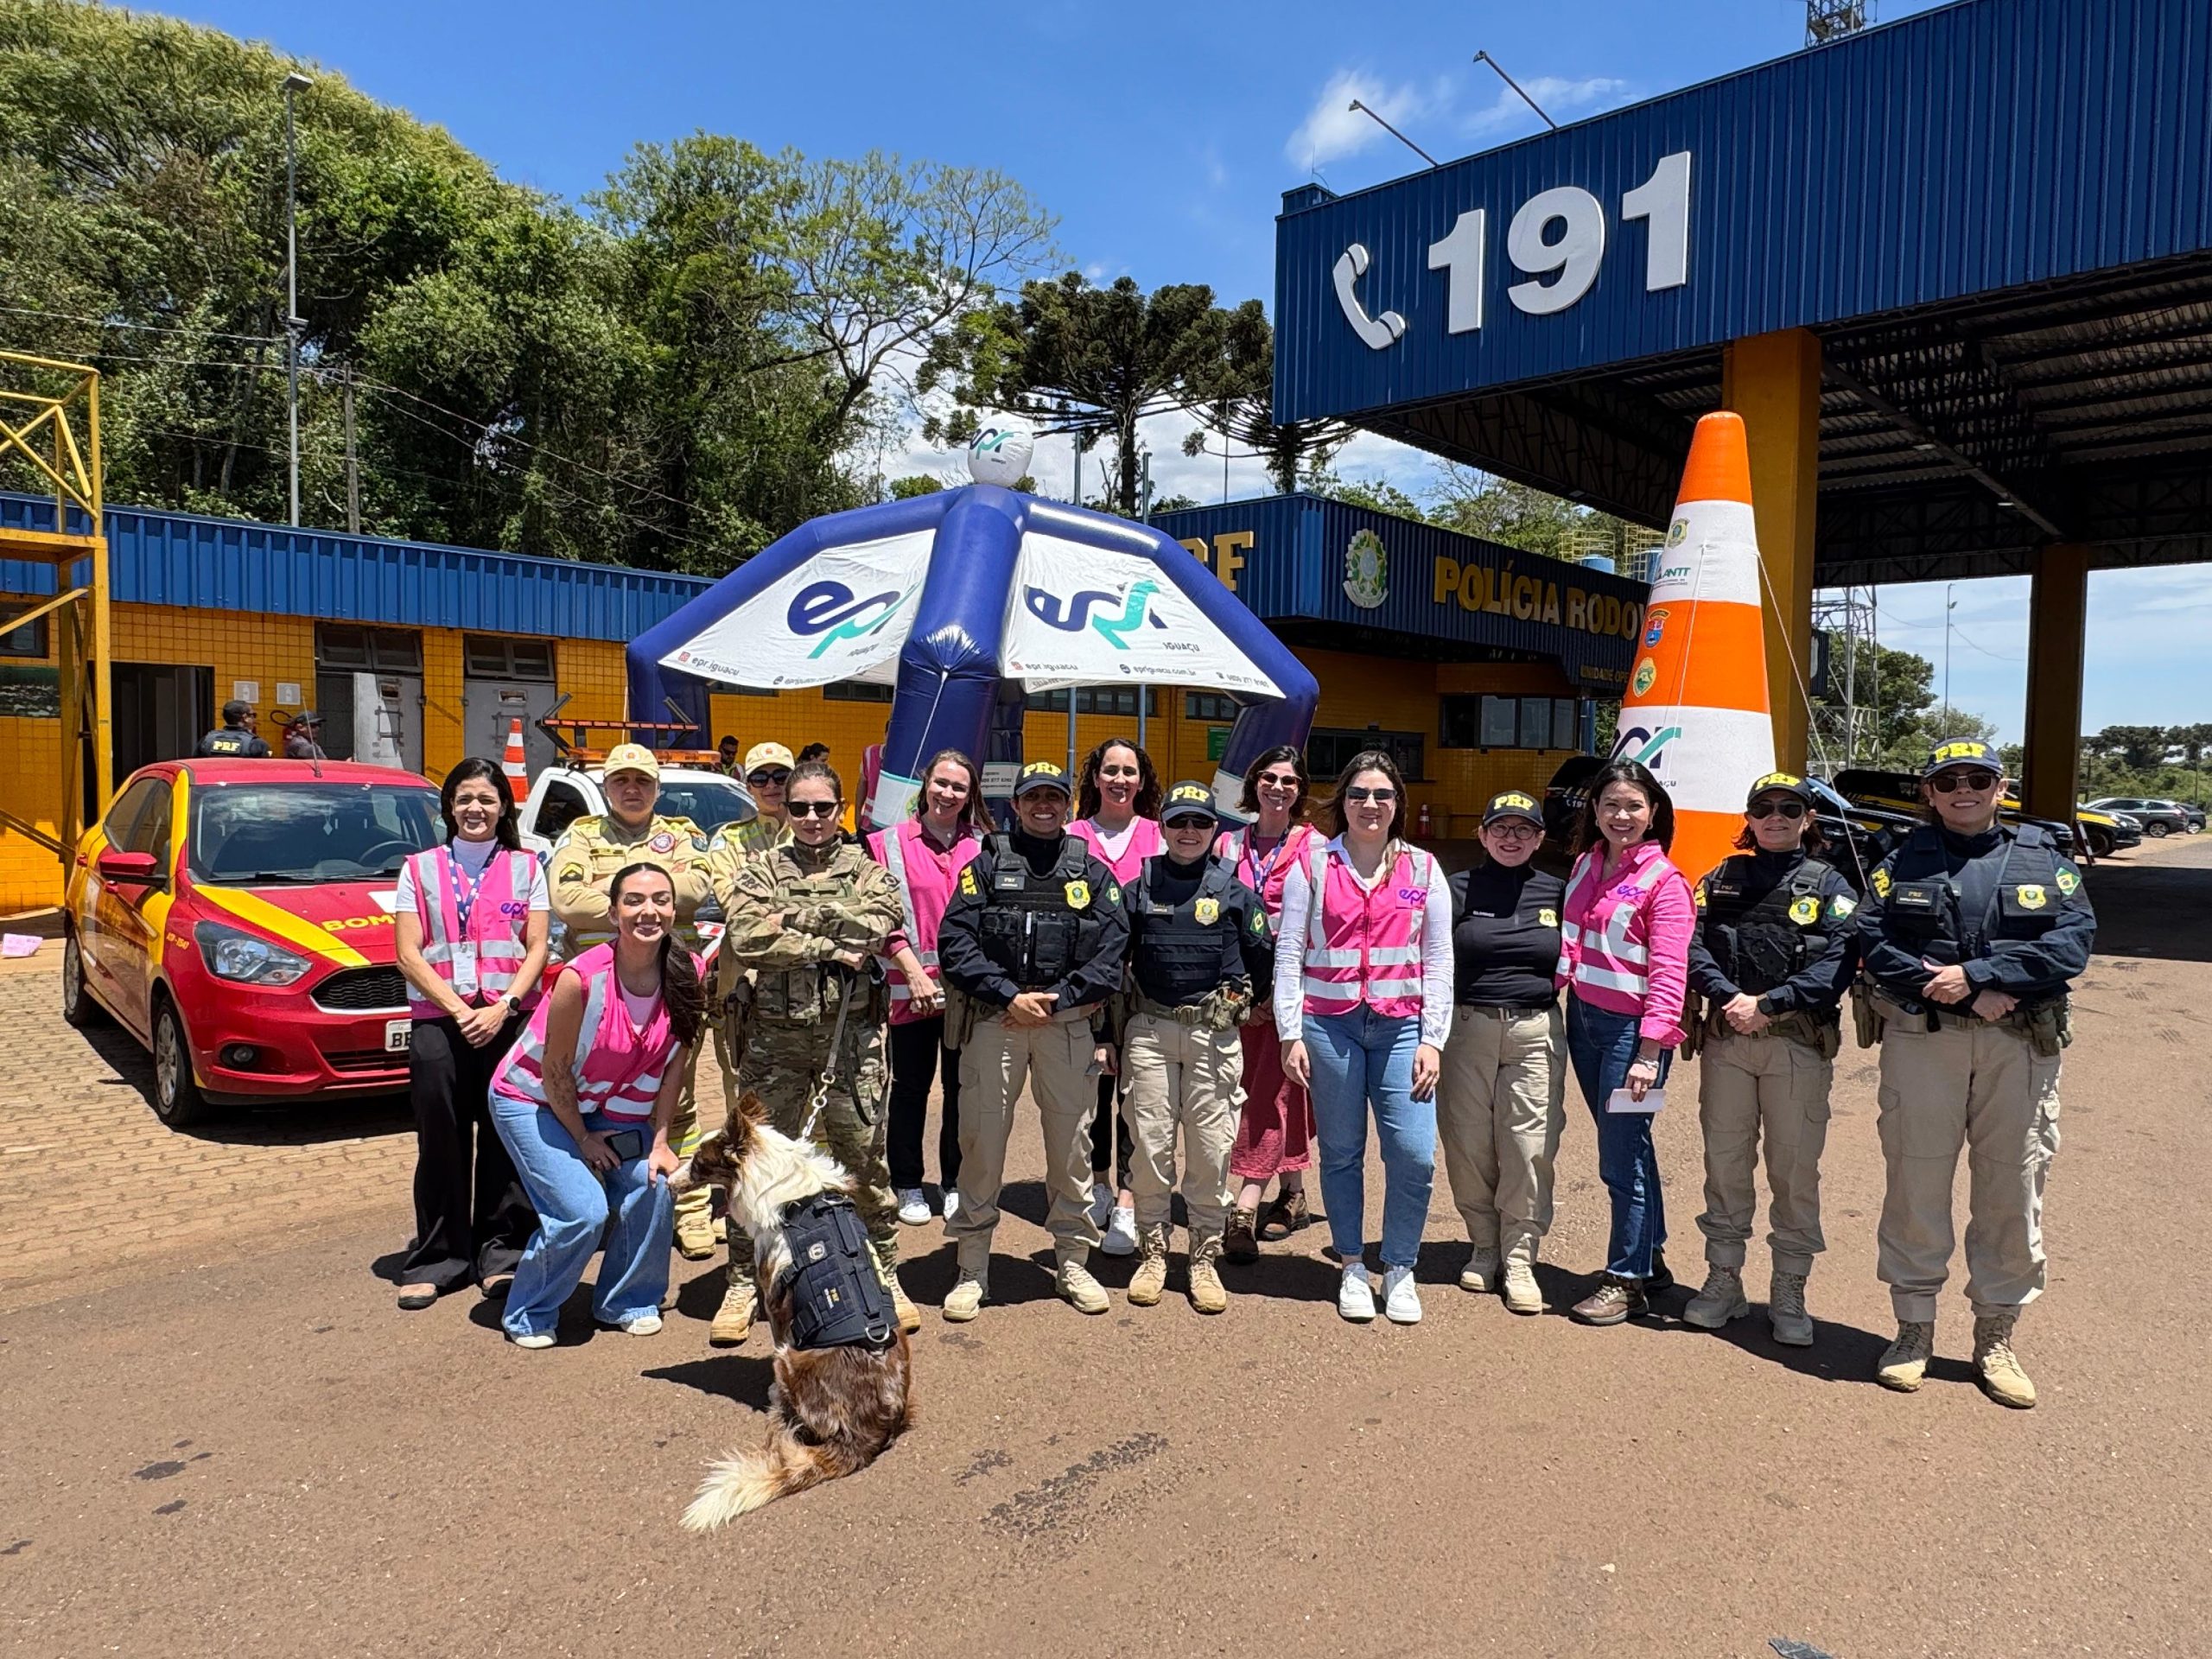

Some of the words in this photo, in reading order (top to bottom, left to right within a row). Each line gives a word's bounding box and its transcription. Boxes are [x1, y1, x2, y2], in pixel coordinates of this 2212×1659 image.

[1427, 150, 1691, 335] 191
[1662, 567, 1691, 577] ANTT
[1433, 555, 1560, 626] POLÍCIA
[213, 741, 241, 752] PRF
[1934, 742, 1986, 764] PRF
[1023, 761, 1063, 778] PRF
[1755, 773, 1801, 790] PRF
[1171, 785, 1210, 803] PRF
[1494, 794, 1534, 811] PRF
[961, 865, 977, 895] PRF
[1872, 868, 1891, 898] PRF
[501, 902, 528, 919] epr
